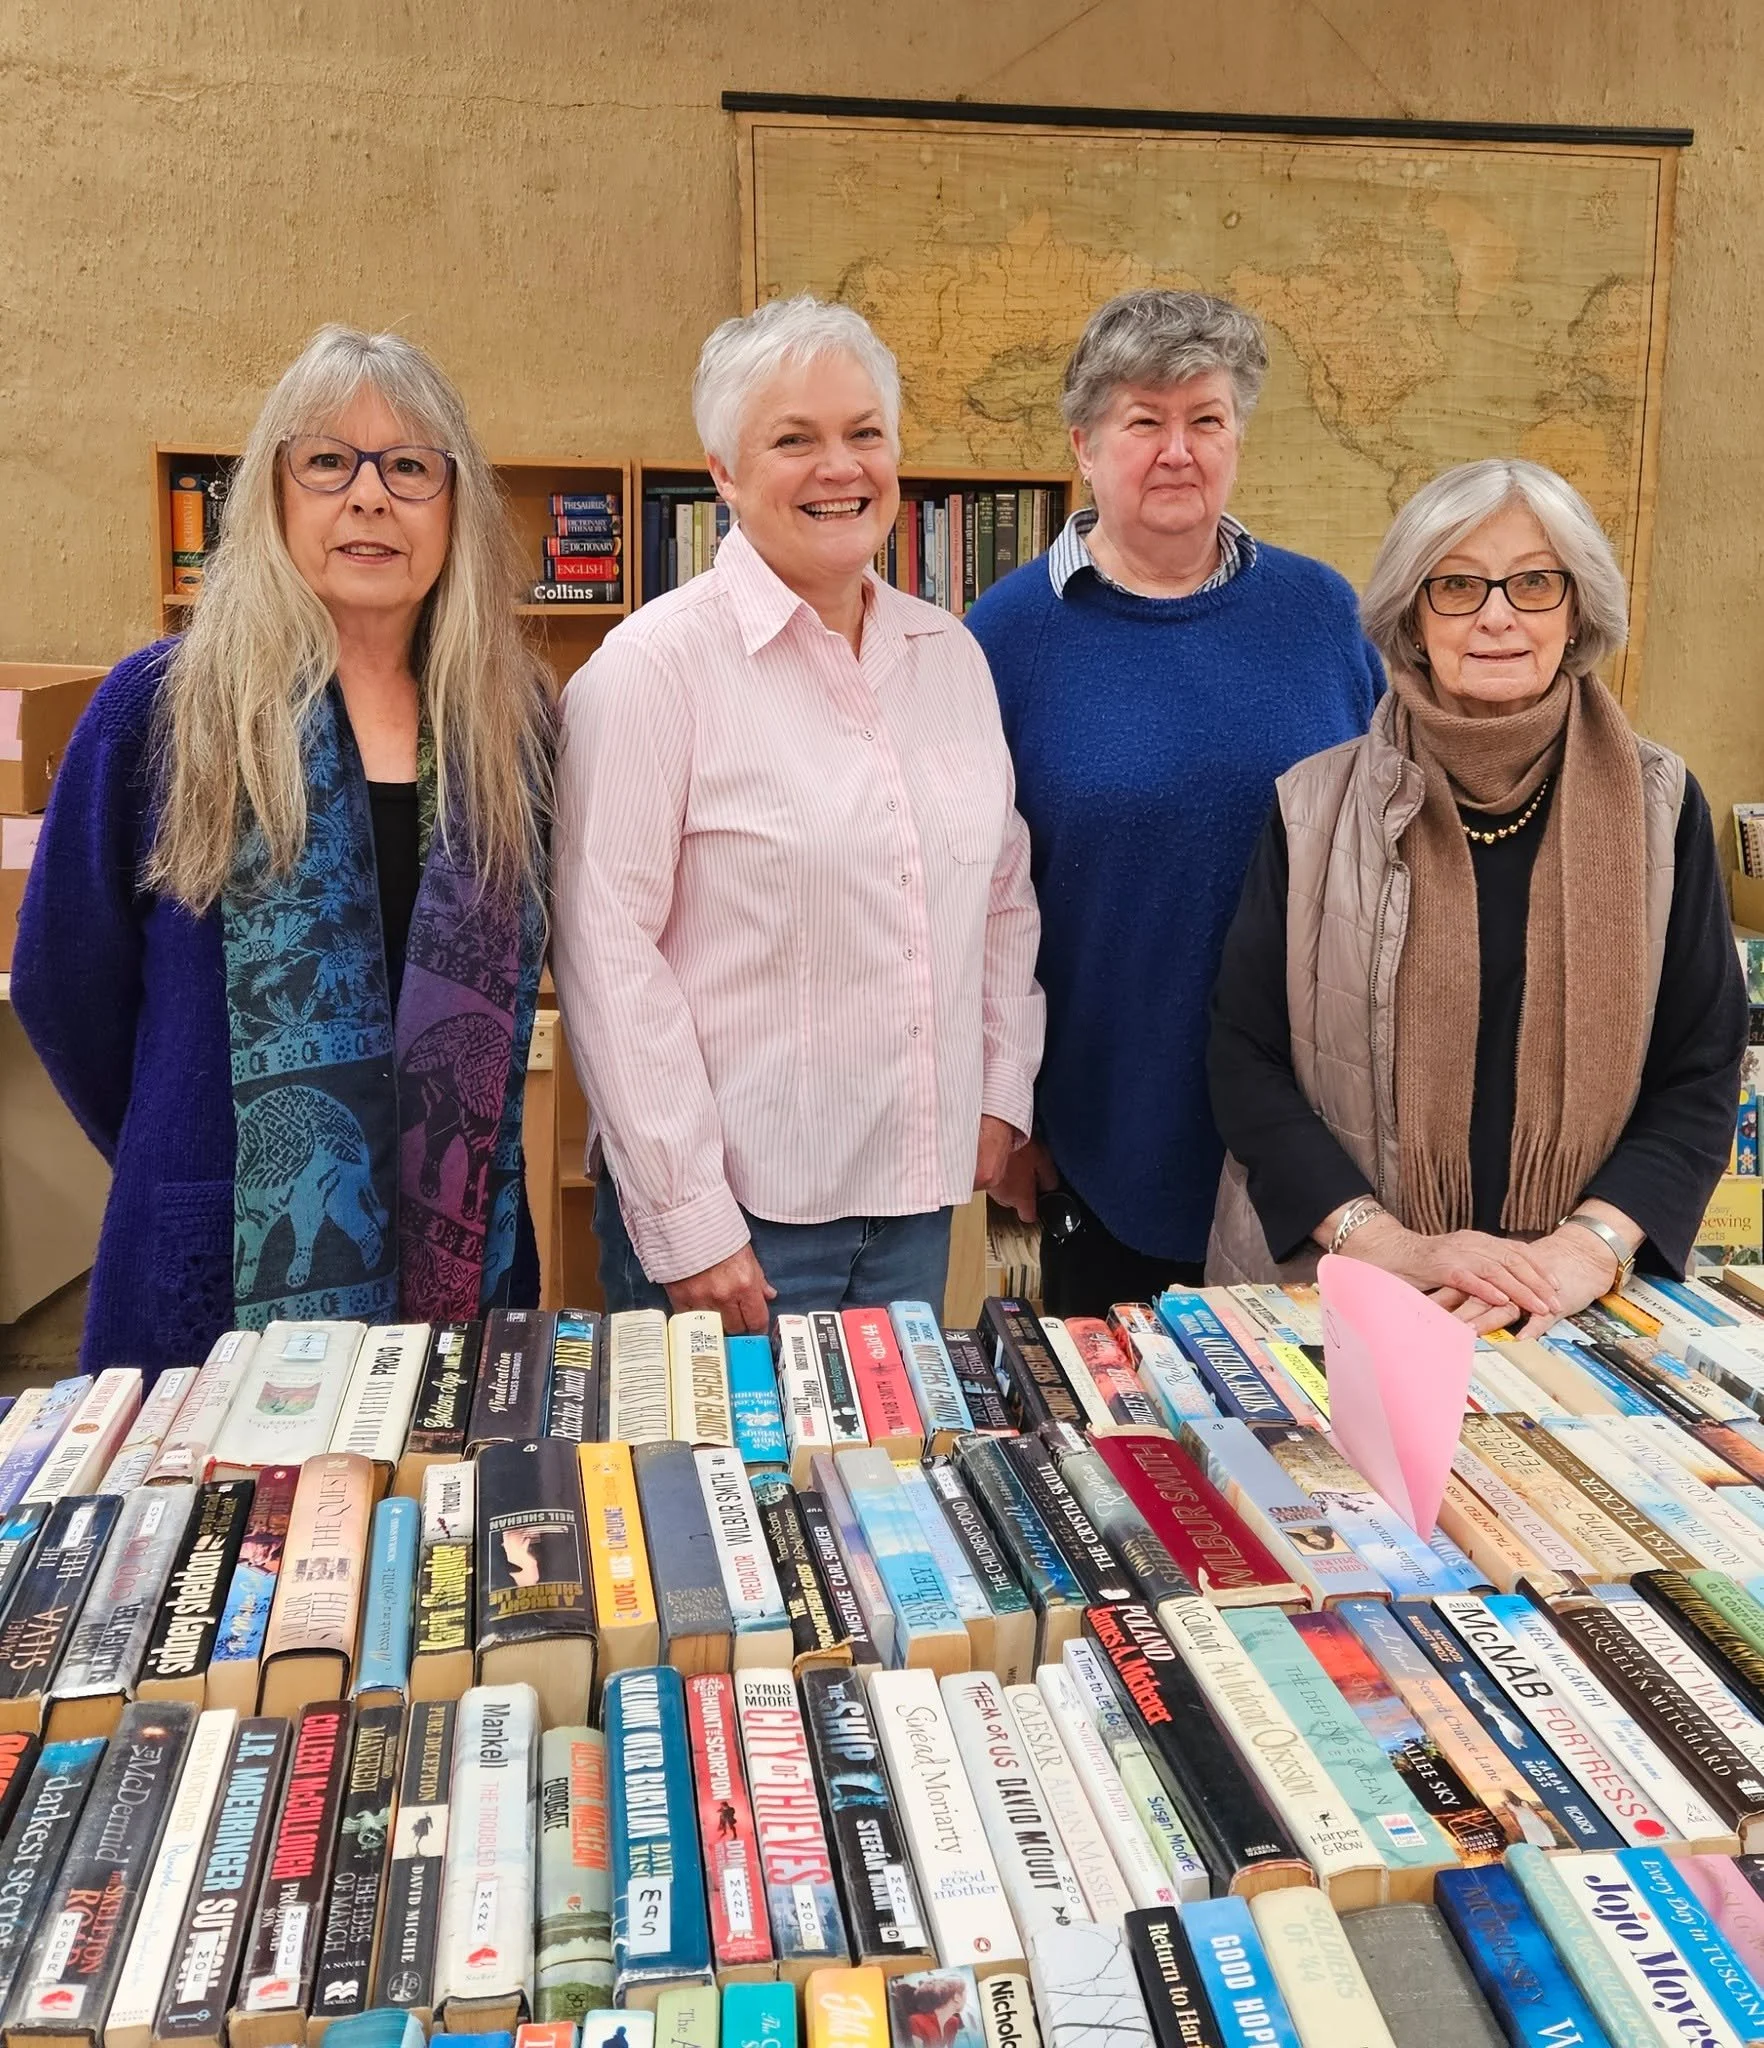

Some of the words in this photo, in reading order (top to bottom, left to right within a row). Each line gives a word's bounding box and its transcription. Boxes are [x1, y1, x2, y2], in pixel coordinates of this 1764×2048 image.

[564, 500, 605, 511] THESAURUS
[557, 564, 604, 575] ENGLISH
[570, 542, 614, 552] DICTIONARY
[534, 583, 594, 600] Collins
[860, 1323, 879, 1335] 44
[866, 1337, 888, 1360] child
[369, 1346, 404, 1376] PROVO
[488, 1351, 512, 1414] Vindication
[691, 1355, 726, 1401] SHELDON
[912, 1344, 952, 1389] SHELDON
[553, 1370, 586, 1402] Smith
[926, 1388, 964, 1426] SIDNEY
[695, 1400, 729, 1441] SIDNEY
[1481, 1420, 1541, 1467] EAGLE
[317, 1472, 352, 1517] QUEST
[710, 1471, 742, 1504] SMITH
[1037, 1462, 1069, 1496] SKULL
[1127, 1443, 1199, 1503] SMITH
[489, 1514, 546, 1530] SHEEHAN
[546, 1511, 576, 1524] NEIL
[951, 1501, 975, 1524] POND
[1058, 1495, 1099, 1545] CRYSTAL
[1476, 1477, 1529, 1522] Trollope
[1580, 1476, 1649, 1529] TUCKER
[311, 1518, 342, 1550] THE
[719, 1502, 752, 1548] WILBUR
[814, 1525, 840, 1562] SHUKER
[1172, 1505, 1262, 1588] WILBUR
[1367, 1518, 1397, 1550] Simons
[1464, 1505, 1511, 1548] TALENTED
[1523, 1523, 1581, 1572] Joanna
[1576, 1512, 1645, 1567] Twining
[1641, 1530, 1687, 1560] LISA
[36, 1546, 63, 1570] THE
[827, 1560, 848, 1587] CARL
[963, 1523, 1003, 1578] CHILDREN'S
[1088, 1544, 1116, 1572] THE
[1123, 1538, 1155, 1578] OWEN
[1397, 1550, 1436, 1589] Paullina
[1506, 1551, 1532, 1568] THE
[734, 1554, 764, 1602] PREDATOR
[911, 1567, 957, 1620] SMILEY
[989, 1575, 1012, 1593] THE
[280, 1592, 312, 1644] WILBUR
[307, 1592, 349, 1644] SMITH
[789, 1598, 807, 1619] THE
[836, 1590, 865, 1637] MISTAKE
[898, 1593, 937, 1629] JANE
[1448, 1600, 1481, 1609] ANDY
[10, 1605, 69, 1670] SILVA
[148, 1614, 216, 1674] sidney
[1116, 1605, 1176, 1661] POLAND
[1452, 1608, 1554, 1699] McNAB
[1087, 1605, 1126, 1648] James
[1120, 1657, 1173, 1726] Michener
[1506, 1603, 1558, 1655] MAUREEN
[1549, 1653, 1611, 1710] McCARTHY
[1614, 1605, 1705, 1677] DEVIANT
[1689, 1682, 1755, 1732] WAYS
[744, 1683, 791, 1696] CYRUS
[744, 1695, 794, 1708] MOORE
[827, 1684, 845, 1701] THE
[963, 1680, 1001, 1721] THEM
[1078, 1657, 1096, 1681] Time
[1105, 1712, 1121, 1726] Go
[1285, 1665, 1310, 1693] THE
[1300, 1692, 1330, 1723] DEEP
[1321, 1720, 1350, 1746] END
[1573, 1615, 1654, 1692] JACQUELYN
[1648, 1694, 1731, 1777] MITCHARD
[1592, 1611, 1647, 1669] THEORY
[1661, 1683, 1753, 1776] RELATIVITY
[425, 1705, 447, 1736] PURE
[479, 1703, 511, 1769] Mankell
[701, 1697, 723, 1731] HUNT
[743, 1709, 807, 1763] CITY
[820, 1701, 878, 1762] SHIP
[895, 1704, 950, 1770] Sinéad
[986, 1725, 1009, 1743] OR
[1011, 1692, 1064, 1771] CAESAR
[1415, 1679, 1445, 1714] Second
[1443, 1714, 1479, 1755] Chance
[1474, 1755, 1502, 1782] Lane
[131, 1744, 163, 1759] Val
[236, 1732, 277, 1763] J.R.
[293, 1713, 340, 1775] COLLEEN
[350, 1725, 386, 1795] MANFREDI
[623, 1731, 664, 1773] OVER
[989, 1747, 1020, 1770] US
[1536, 1707, 1648, 1818] FORTRESS
[418, 1735, 444, 1801] DECEPTION
[706, 1736, 732, 1801] SCORPION
[771, 1765, 799, 1778] OF
[1074, 1721, 1110, 1776] Southern
[1104, 1777, 1133, 1823] Charm
[1347, 1758, 1393, 1806] OCEAN
[1392, 1730, 1435, 1781] MALLEE
[1428, 1776, 1461, 1806] SKY
[1522, 1759, 1554, 1789] MOSS
[1535, 1759, 1572, 1794] SARAH
[95, 1755, 162, 1865] McDermid
[480, 1780, 500, 1803] THE
[543, 1776, 570, 1834] FLOODGATE
[921, 1770, 962, 1855] Moriarty
[995, 1777, 1042, 1824] DAVID
[13, 1777, 83, 1867] darkest
[202, 1767, 270, 1892] MOEHRINGER
[271, 1776, 329, 1880] McCULLOUGH
[476, 1806, 499, 1868] TROUBLED
[753, 1778, 832, 1885] THIEVES
[856, 1819, 892, 1870] STEFÁN
[1147, 1796, 1173, 1831] Susan
[1167, 1834, 1196, 1873] Moore
[1310, 1828, 1360, 1846] Harper
[333, 1872, 357, 1893] OF
[354, 1873, 379, 1905] THE
[407, 1865, 425, 1906] DAVID
[934, 1884, 999, 1901] mother
[940, 1871, 986, 1889] good
[1640, 1858, 1676, 1895] Every
[1667, 1897, 1707, 1926] Day
[1688, 1928, 1710, 1942] in
[78, 1884, 127, 1975] SKELETON
[324, 1893, 353, 1954] MARCH
[350, 1907, 375, 1944] IDES
[1583, 1874, 1651, 1941] Jojo
[400, 1911, 421, 1964] MICHIE
[1283, 1922, 1315, 1948] OF
[1304, 1904, 1364, 1999] SOLDIERS
[336, 1960, 367, 1969] NOVEL
[1147, 1922, 1181, 1983] Return
[1169, 1986, 1190, 2007] to
[1210, 1934, 1257, 1990] GOOD
[677, 2007, 696, 2033] The
